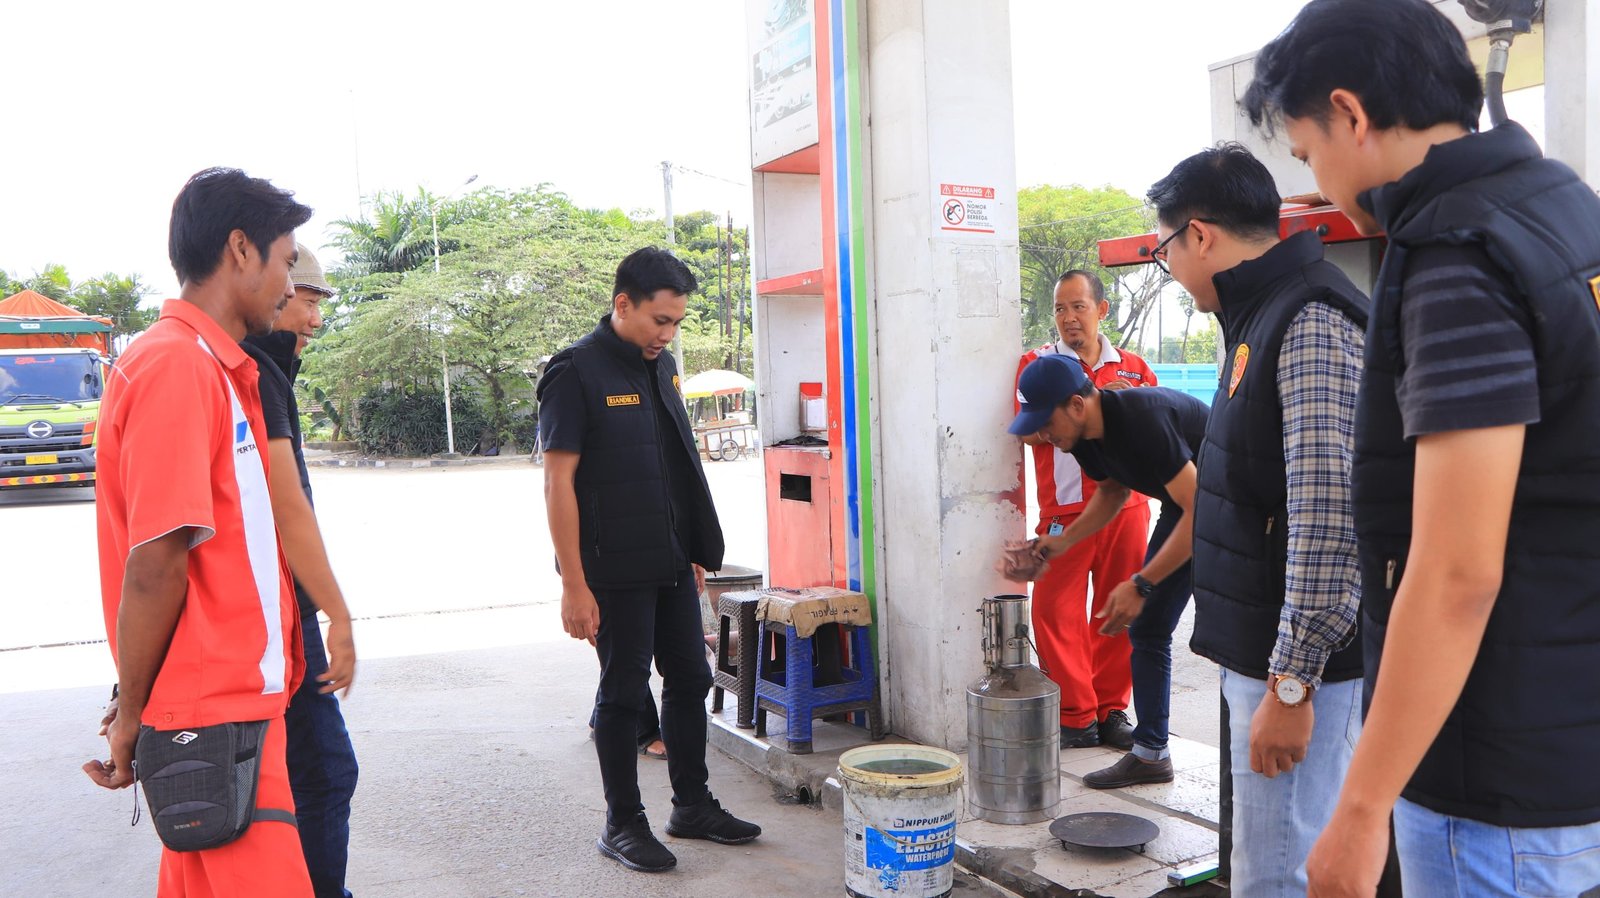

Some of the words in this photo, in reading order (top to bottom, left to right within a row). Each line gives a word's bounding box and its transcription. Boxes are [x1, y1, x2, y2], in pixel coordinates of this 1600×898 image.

[953, 186, 982, 194] DILARANG
[609, 396, 637, 404] RIANDIKA
[905, 817, 939, 827] NIPPON
[905, 847, 949, 863] WATERPROOF
